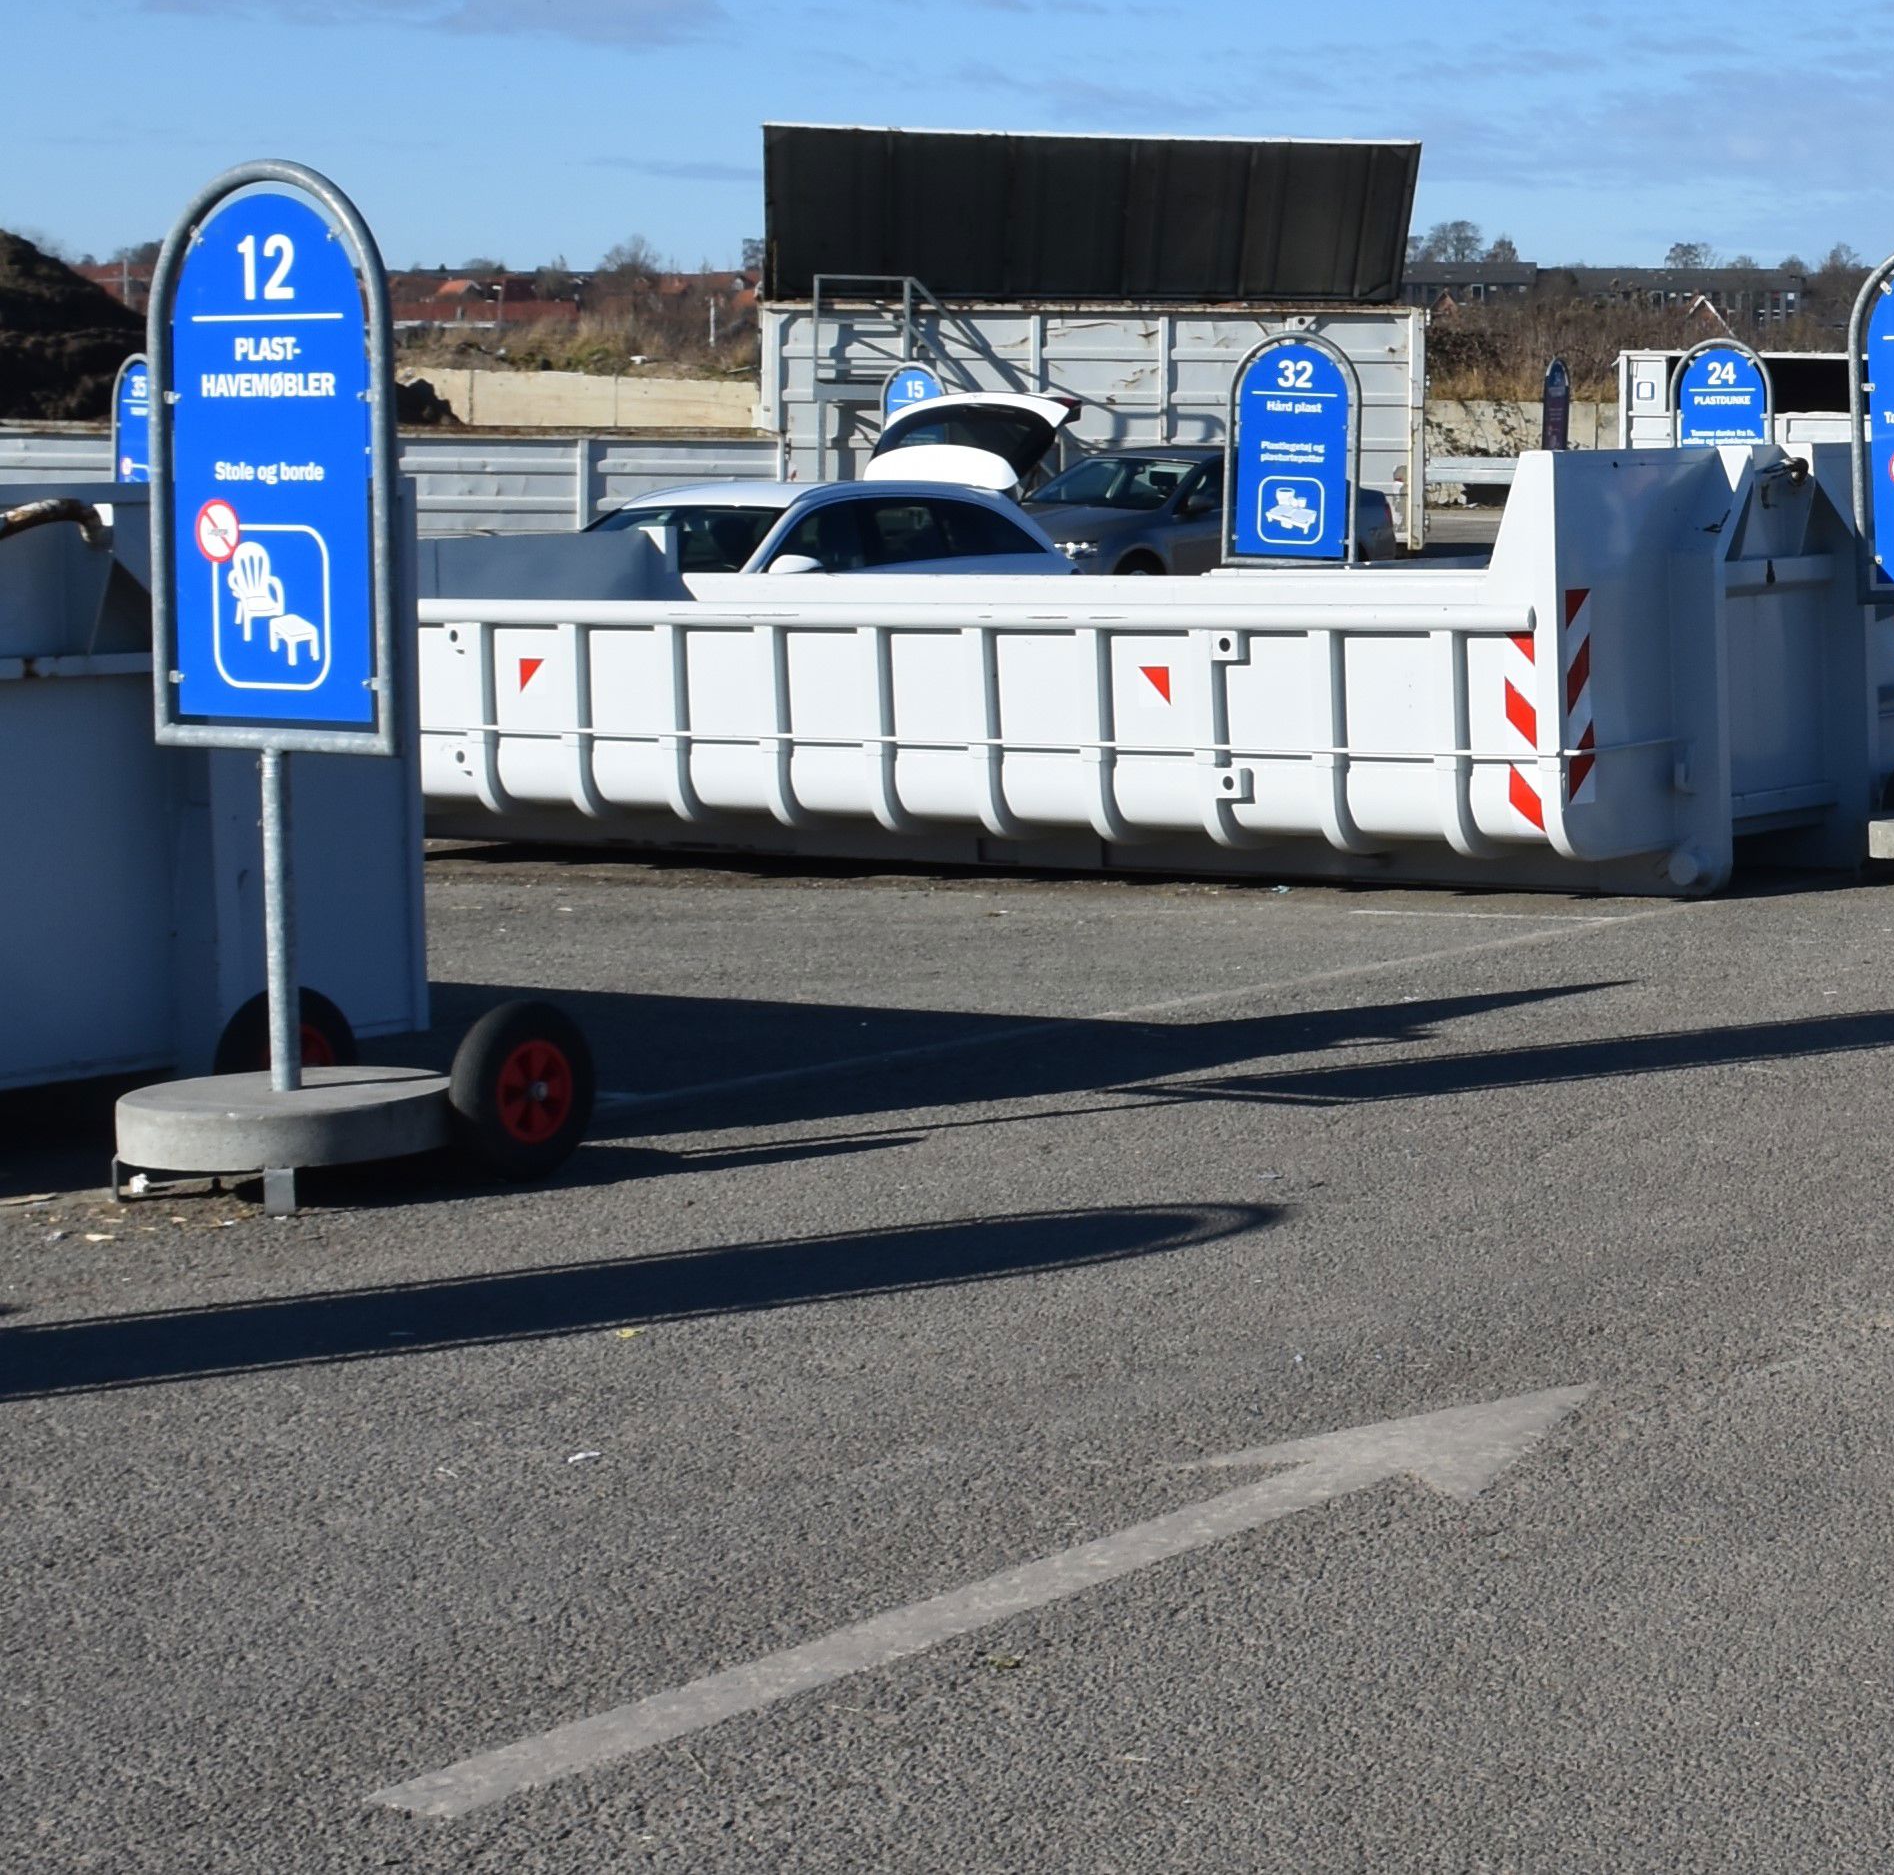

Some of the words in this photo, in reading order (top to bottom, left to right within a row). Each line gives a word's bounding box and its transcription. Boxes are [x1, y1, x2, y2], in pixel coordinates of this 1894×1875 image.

[237, 234, 294, 300] 12
[234, 336, 302, 361] PLAST-
[201, 372, 336, 398] HAVEMØBLER
[1277, 360, 1313, 388] 32
[1707, 362, 1736, 385] 24
[906, 380, 924, 399] 15
[1694, 396, 1751, 405] PLASTDUNKE
[1266, 400, 1293, 412] Hård
[1294, 402, 1322, 414] plast
[214, 461, 255, 481] Stole
[257, 464, 279, 485] og
[280, 461, 325, 481] borde
